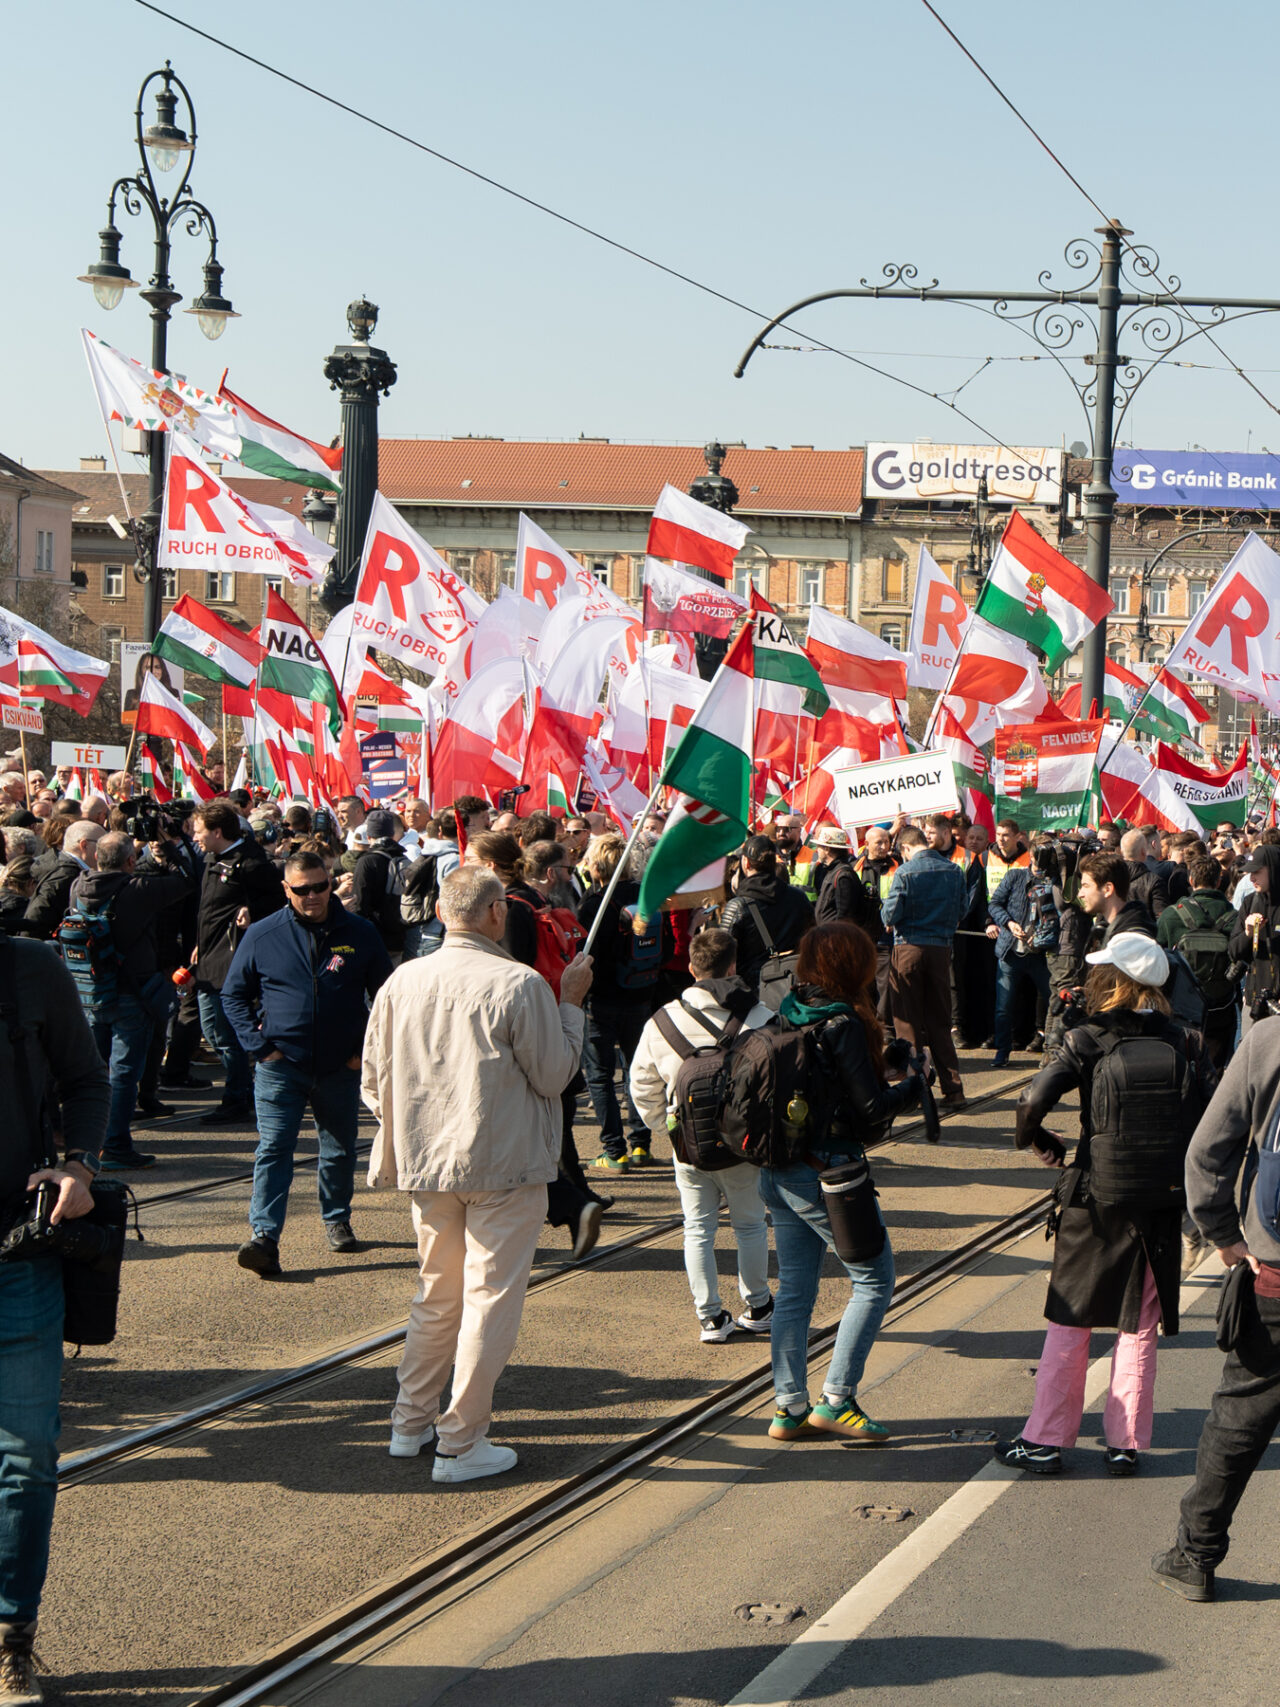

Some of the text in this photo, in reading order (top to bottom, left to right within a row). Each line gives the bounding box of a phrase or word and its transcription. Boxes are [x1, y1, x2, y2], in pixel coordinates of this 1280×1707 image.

[908, 457, 1057, 484] goldtresor
[1161, 469, 1223, 488] Gránit
[1227, 472, 1277, 490] Bank
[168, 455, 226, 534] R
[167, 540, 217, 556] RUCH
[357, 530, 421, 623] R
[353, 611, 398, 641] RUCH
[1195, 571, 1270, 676] R
[920, 652, 954, 670] RUC
[1041, 729, 1097, 747] FELVIDÉK
[74, 745, 105, 764] TÉT
[848, 770, 942, 800] NAGYKÁROLY
